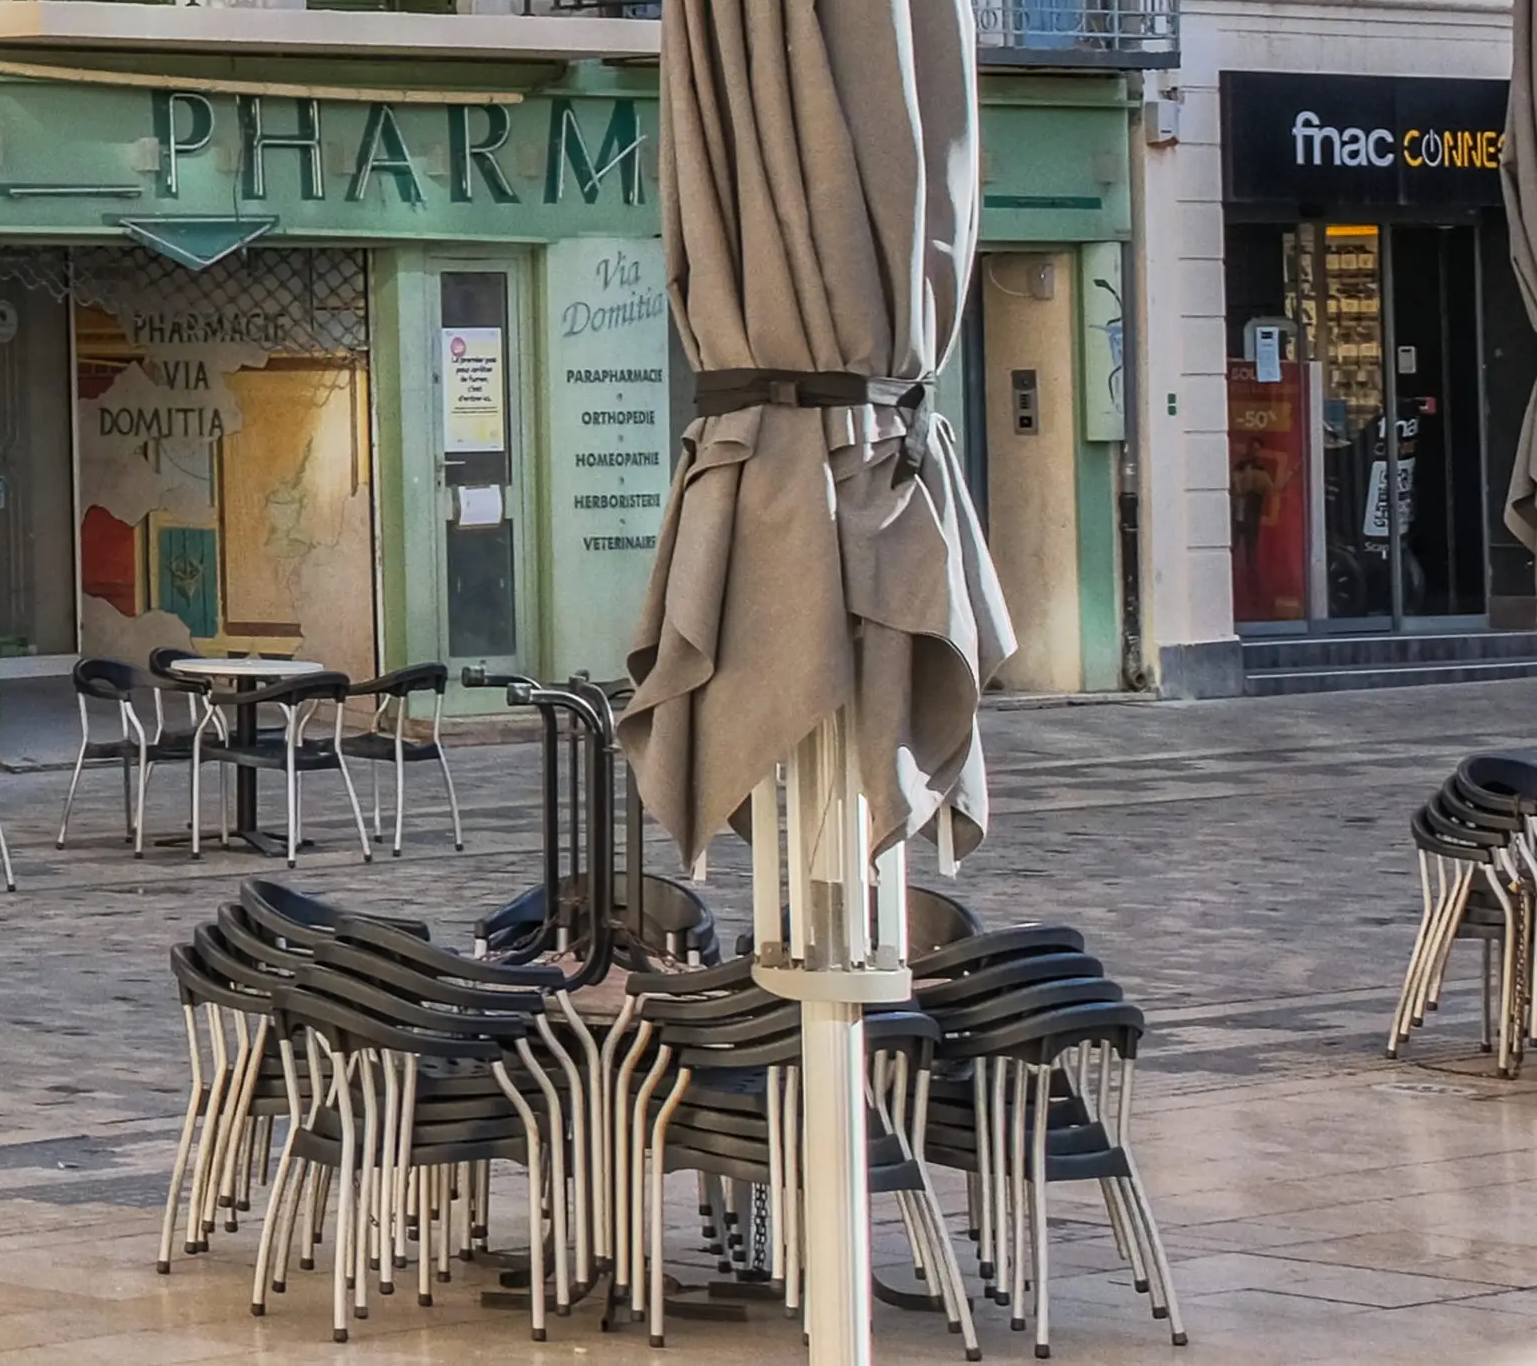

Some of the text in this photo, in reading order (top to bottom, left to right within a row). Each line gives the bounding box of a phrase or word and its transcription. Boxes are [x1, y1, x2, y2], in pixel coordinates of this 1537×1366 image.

[152, 89, 647, 205] PHARM
[1292, 111, 1394, 167] fnac
[596, 251, 641, 291] Via
[562, 287, 665, 337] Domitia
[133, 313, 287, 344] PHARMACIE
[163, 360, 210, 390] VIA
[566, 369, 663, 383] PARAPHARMACIE
[99, 407, 224, 437] DOMITIA
[581, 410, 655, 425] ORTHOPEDIE
[575, 452, 659, 467] HOMEOPATHIE
[574, 493, 661, 509] HERBORISTERIE
